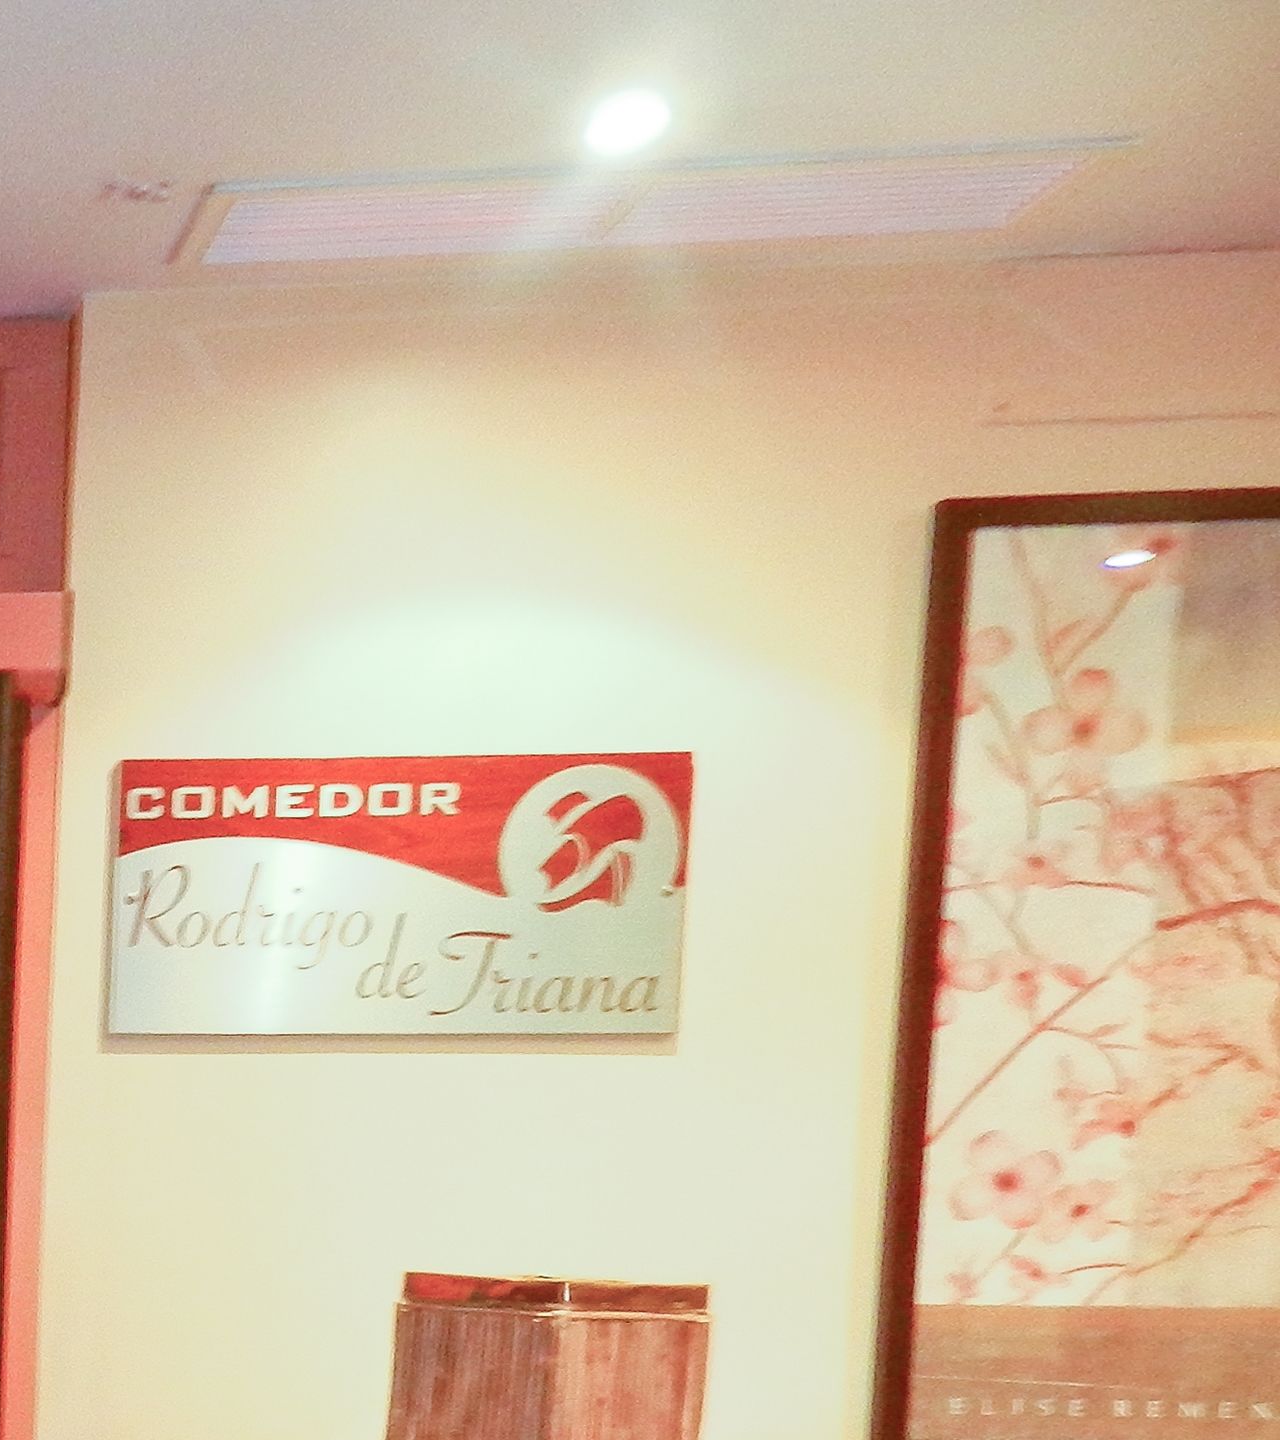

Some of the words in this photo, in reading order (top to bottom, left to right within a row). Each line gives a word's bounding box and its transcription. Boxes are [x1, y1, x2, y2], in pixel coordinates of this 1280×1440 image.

[125, 782, 461, 820] COMEDOR
[123, 864, 374, 970] Rodrigo
[355, 912, 427, 1000] de
[429, 930, 660, 1016] Triana
[948, 1397, 1086, 1417] ELISE
